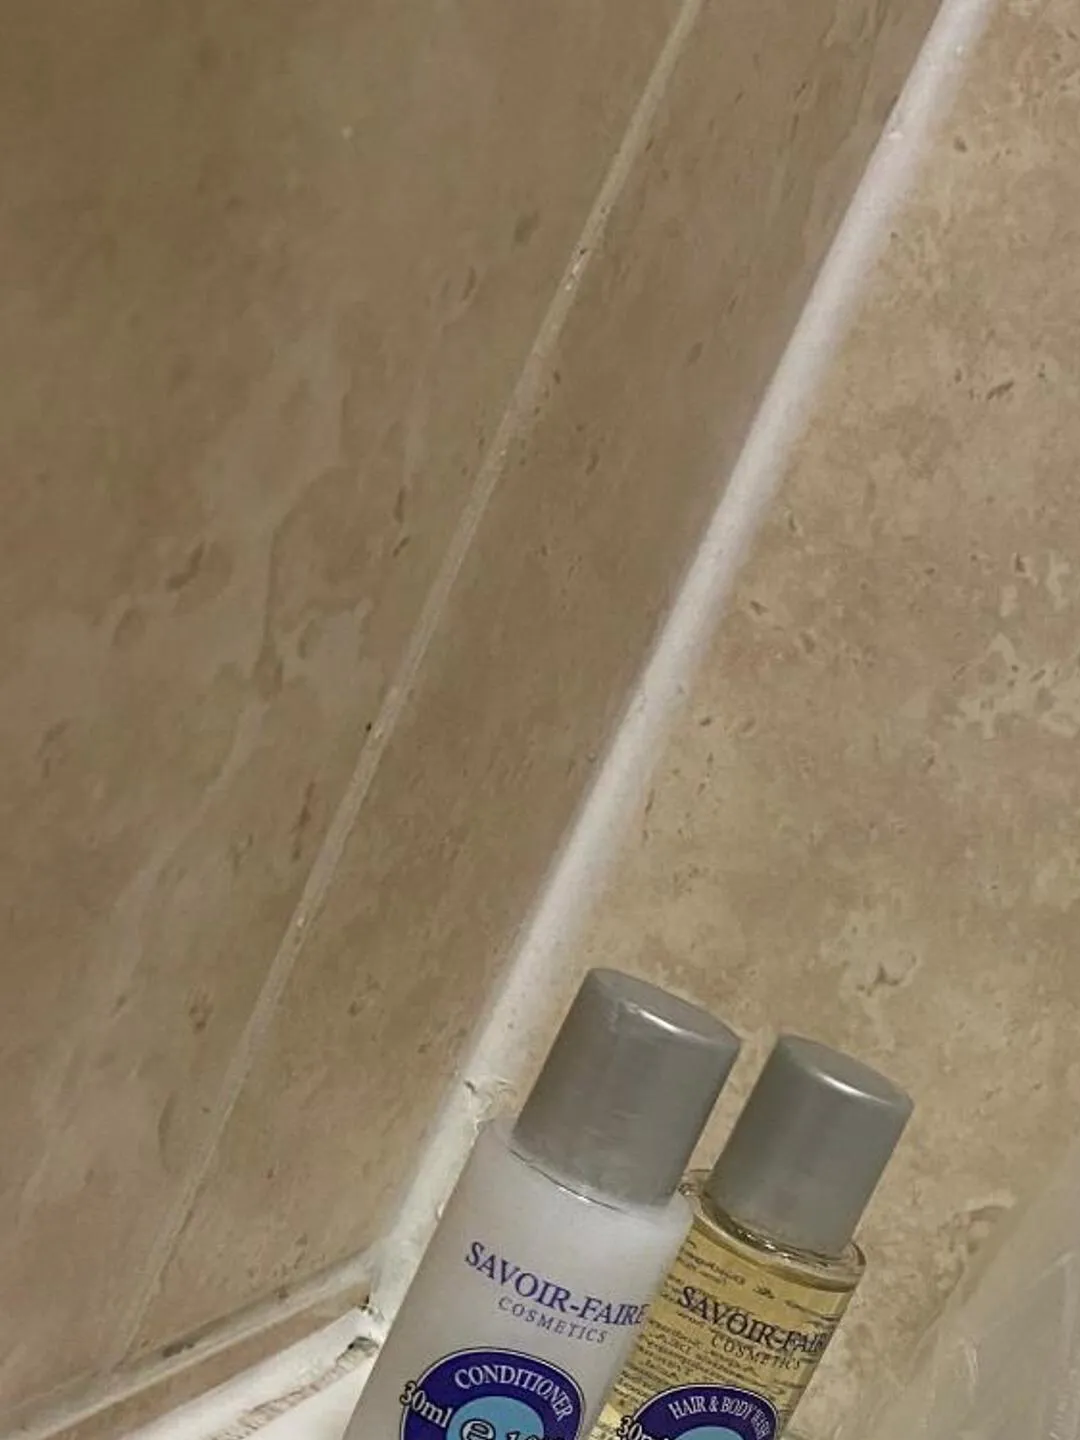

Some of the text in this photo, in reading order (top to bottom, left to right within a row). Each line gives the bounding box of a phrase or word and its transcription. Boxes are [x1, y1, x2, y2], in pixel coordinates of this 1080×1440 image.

[464, 1241, 650, 1327] SAVOIR-FAIRE
[499, 1296, 607, 1343] COSMETICS
[711, 1331, 801, 1370] COSMETICS
[400, 1380, 452, 1428] 30ml
[455, 1365, 573, 1422] CONDITIONER
[668, 1397, 707, 1420] HAIR
[709, 1396, 719, 1412] &
[721, 1397, 755, 1420] BODY
